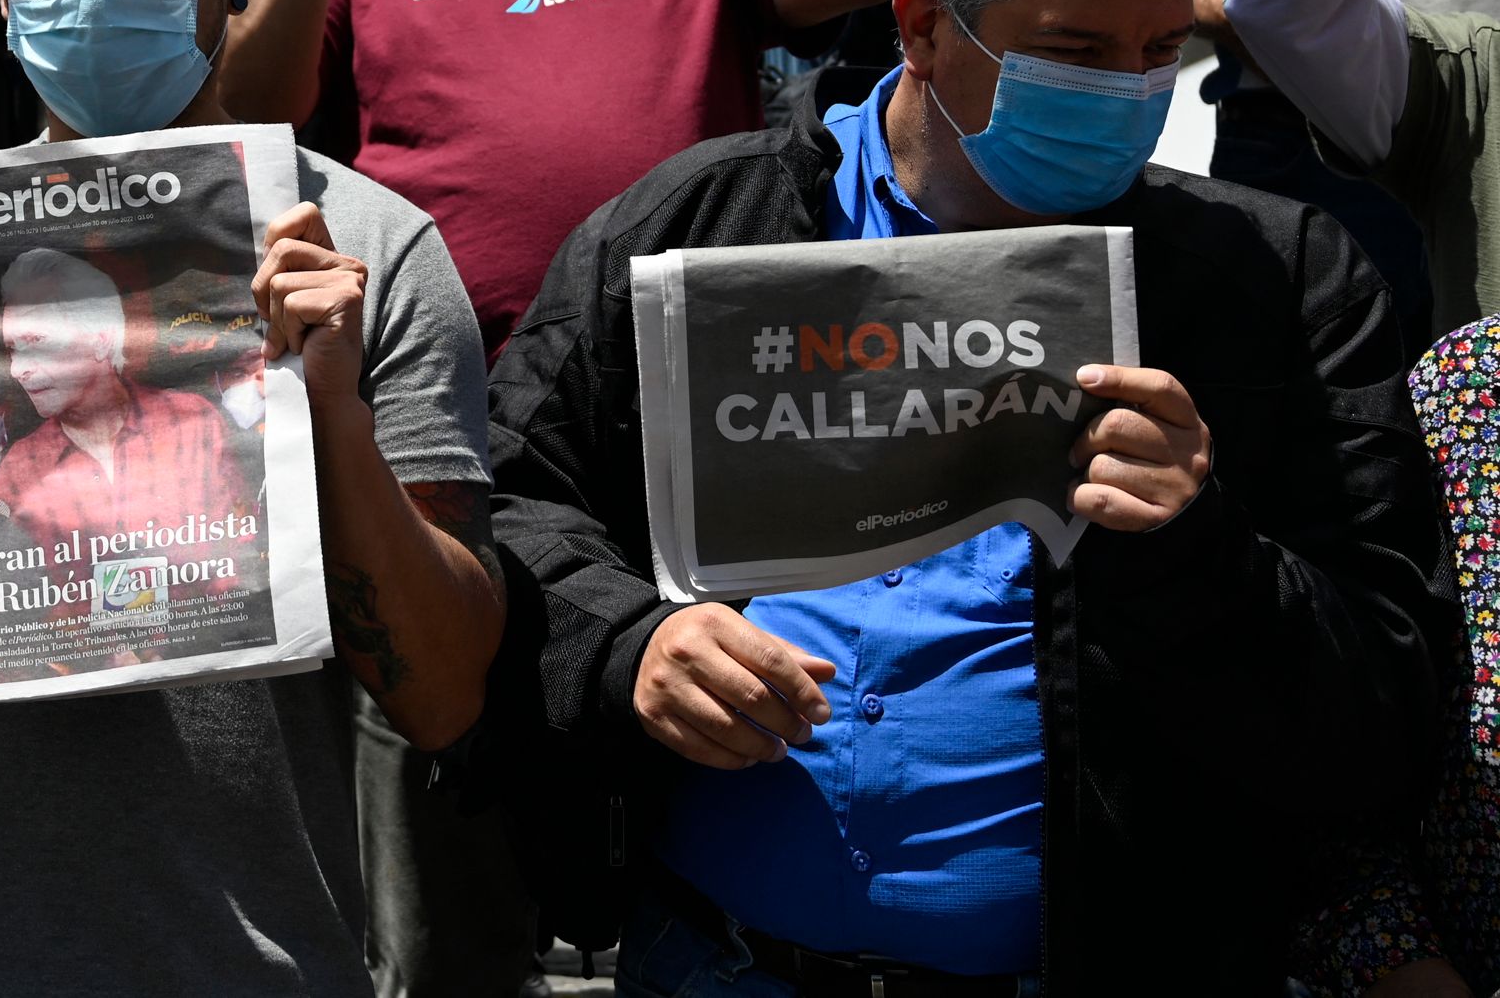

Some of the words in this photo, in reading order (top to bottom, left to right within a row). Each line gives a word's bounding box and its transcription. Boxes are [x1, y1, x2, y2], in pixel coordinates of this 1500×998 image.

[752, 319, 1045, 373] #NONOS
[715, 374, 1082, 442] CALLARÁN
[54, 529, 81, 564] al
[89, 511, 258, 564] periodista
[106, 556, 236, 598] Zamora
[8, 632, 53, 643] elPeriódico.
[55, 629, 63, 637] El
[65, 624, 101, 636] operativo
[112, 617, 134, 627] inició
[152, 611, 173, 621] 14:00
[175, 609, 199, 617] horas.
[200, 606, 206, 614] A
[207, 605, 218, 613] las
[220, 601, 244, 611] 23:00
[15, 622, 47, 631] Público
[77, 611, 105, 622] Policía
[107, 604, 143, 617] Nacional
[145, 601, 165, 611] Civil
[167, 596, 204, 607] allanaron
[218, 590, 249, 599] oficinas
[50, 641, 71, 649] Torre
[73, 638, 83, 646] de
[84, 633, 127, 644] Tribunales.
[129, 629, 135, 637] A
[148, 624, 166, 634] 0:00
[167, 622, 189, 631] horas
[190, 619, 200, 627] de
[201, 617, 218, 625] este
[219, 612, 247, 622] sábado
[8, 657, 33, 666] medio
[36, 650, 80, 664] permanecía
[82, 645, 114, 656] retenido
[139, 638, 171, 647] oficinas.
